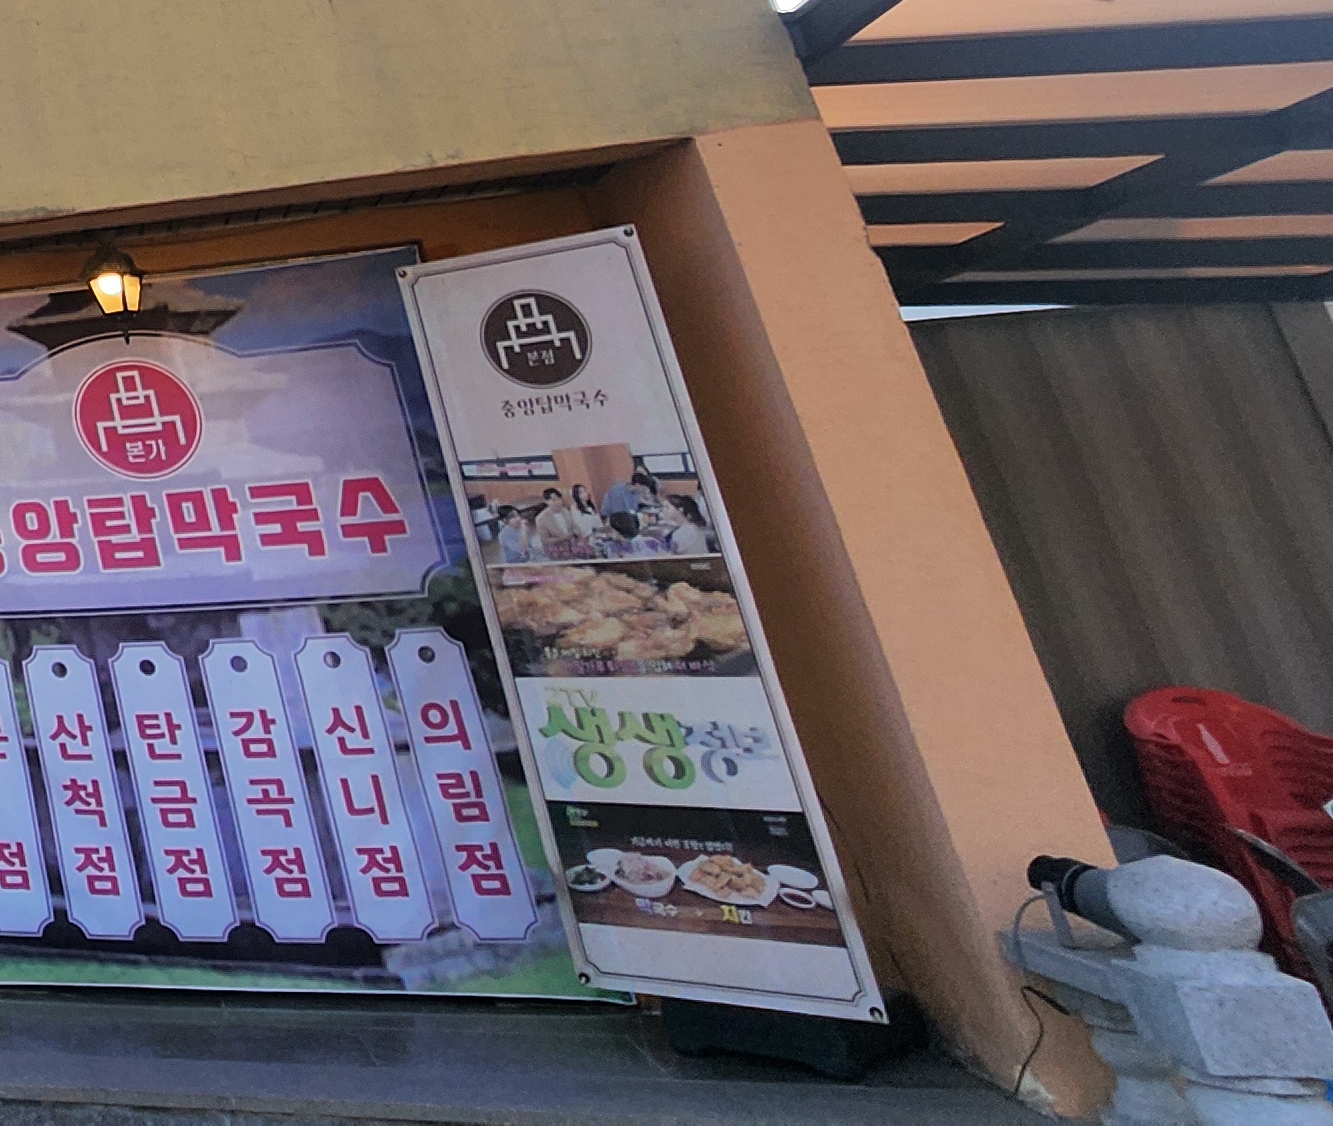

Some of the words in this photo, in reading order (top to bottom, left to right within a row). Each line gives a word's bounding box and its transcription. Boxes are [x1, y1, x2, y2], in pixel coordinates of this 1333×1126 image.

[125, 439, 166, 463] 본가
[500, 389, 609, 418] 중앙탑막국수
[48, 714, 122, 898] 산척점
[135, 712, 214, 899] 탄금점
[232, 709, 313, 899] 감곡점
[325, 705, 410, 899] 신니점
[419, 700, 512, 898] 의림점
